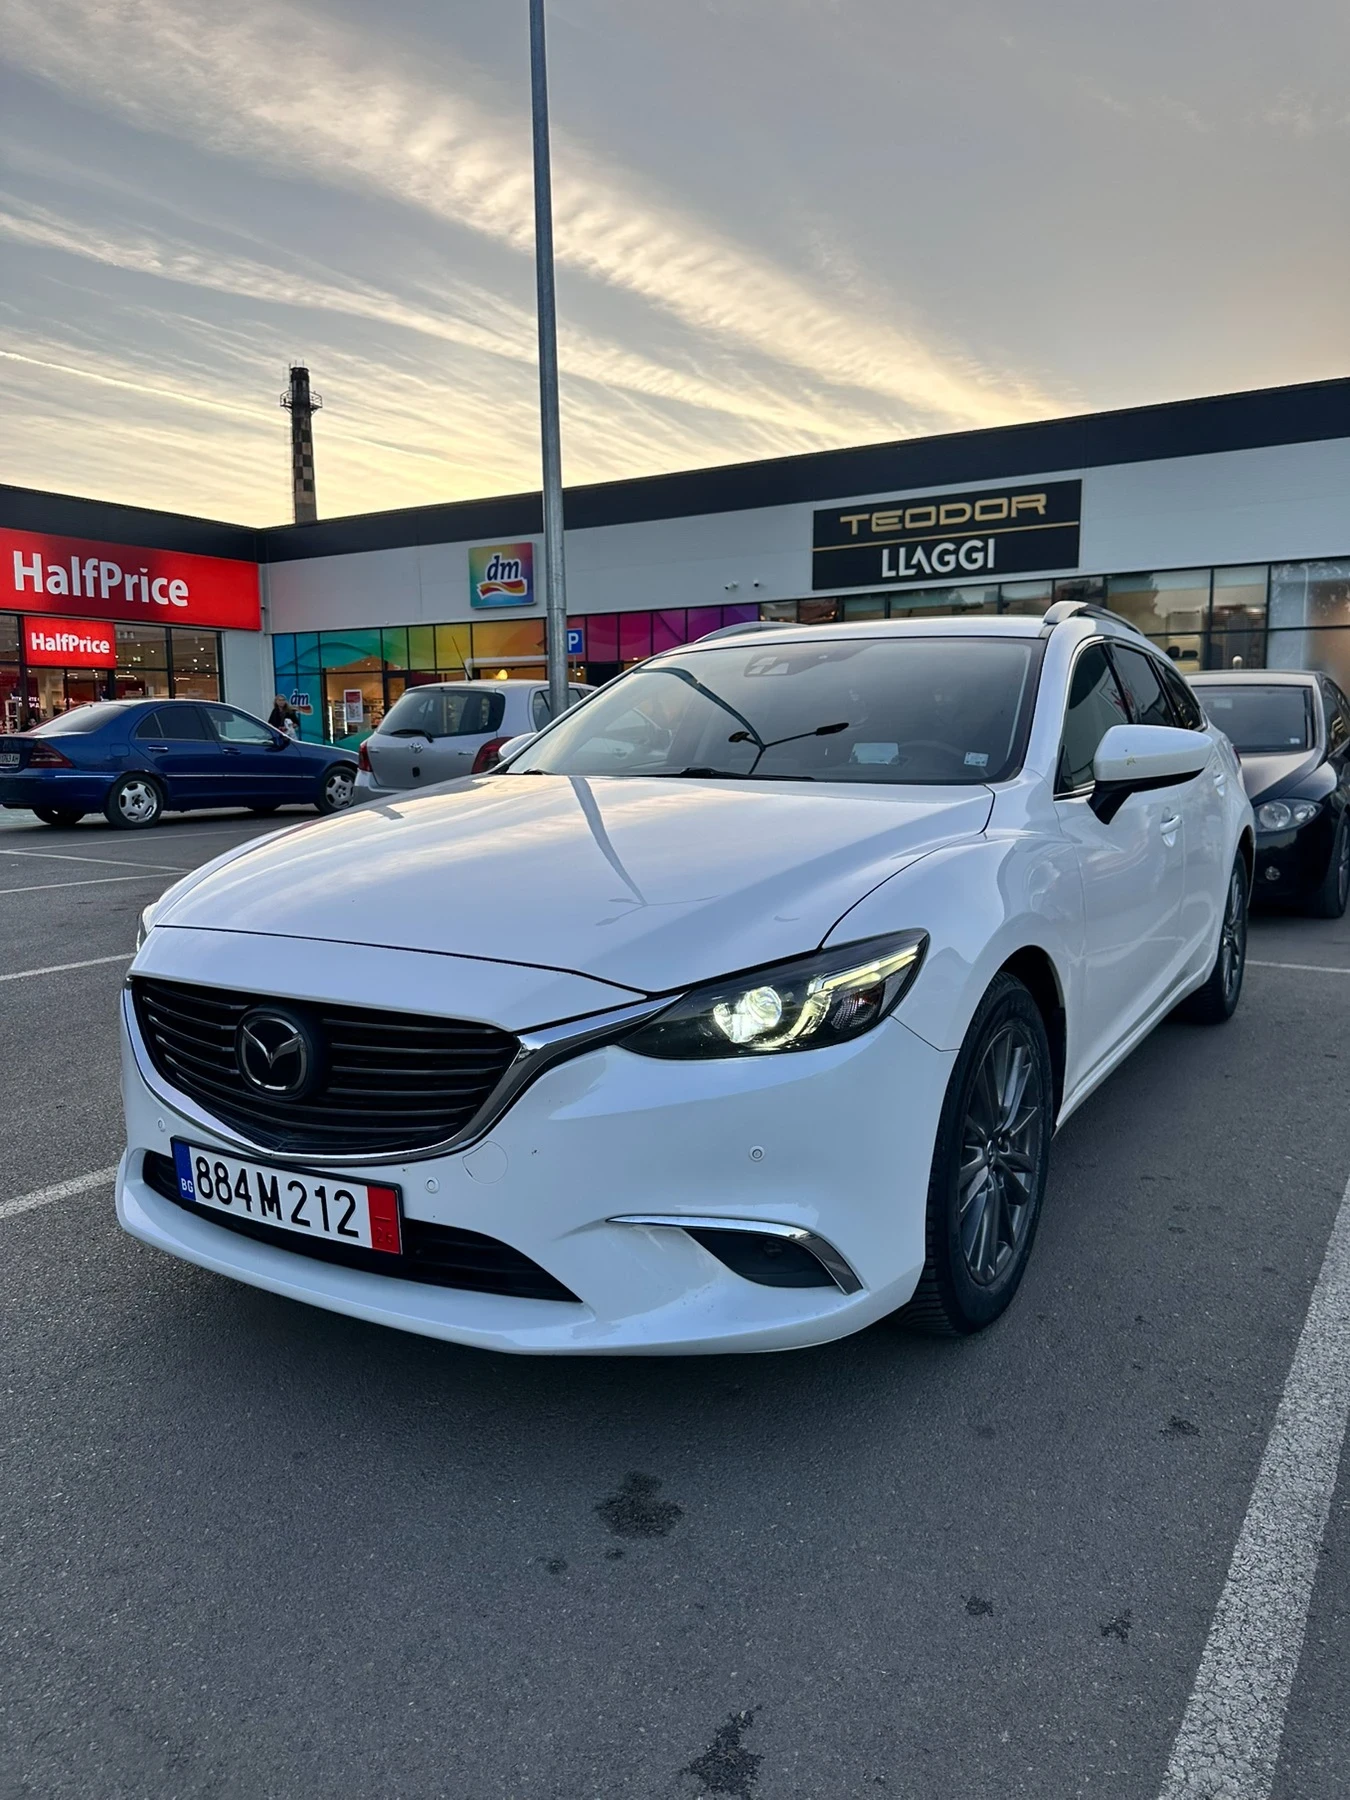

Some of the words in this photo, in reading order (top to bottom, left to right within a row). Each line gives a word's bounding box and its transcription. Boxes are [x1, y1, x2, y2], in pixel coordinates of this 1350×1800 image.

[839, 492, 1048, 536] TEODOR
[486, 555, 520, 581] dm
[881, 538, 996, 579] LLAGGI
[13, 550, 189, 607] HalfPrice
[31, 632, 110, 654] HalfPrice
[568, 632, 579, 652] P
[290, 690, 309, 706] dm
[180, 1178, 194, 1193] BG
